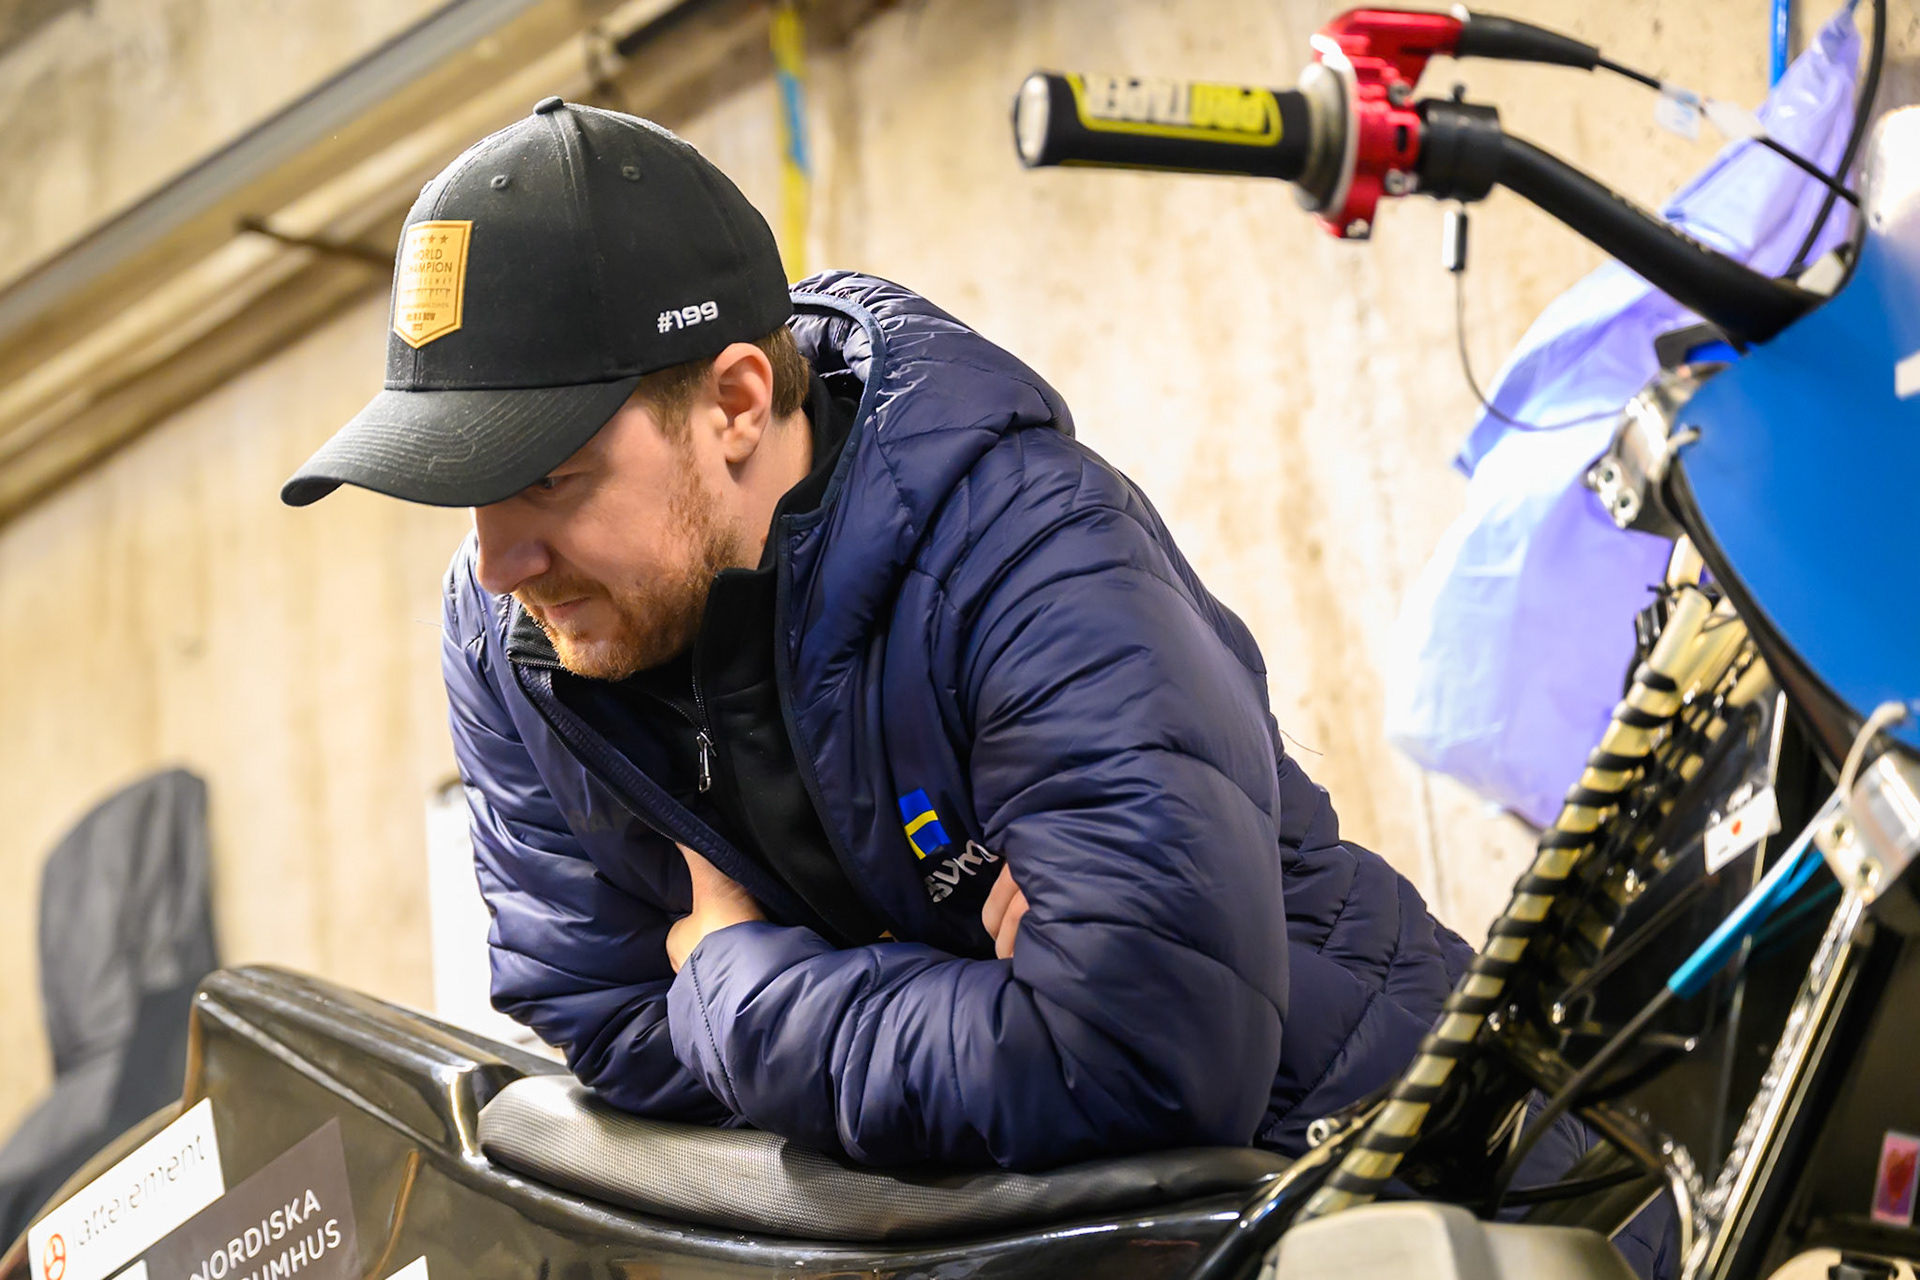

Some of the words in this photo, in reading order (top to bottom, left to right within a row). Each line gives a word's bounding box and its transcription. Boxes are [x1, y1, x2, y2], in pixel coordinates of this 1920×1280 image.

[406, 262, 453, 275] HAMPION
[657, 300, 719, 334] #199
[190, 1189, 321, 1280] NORDISKA
